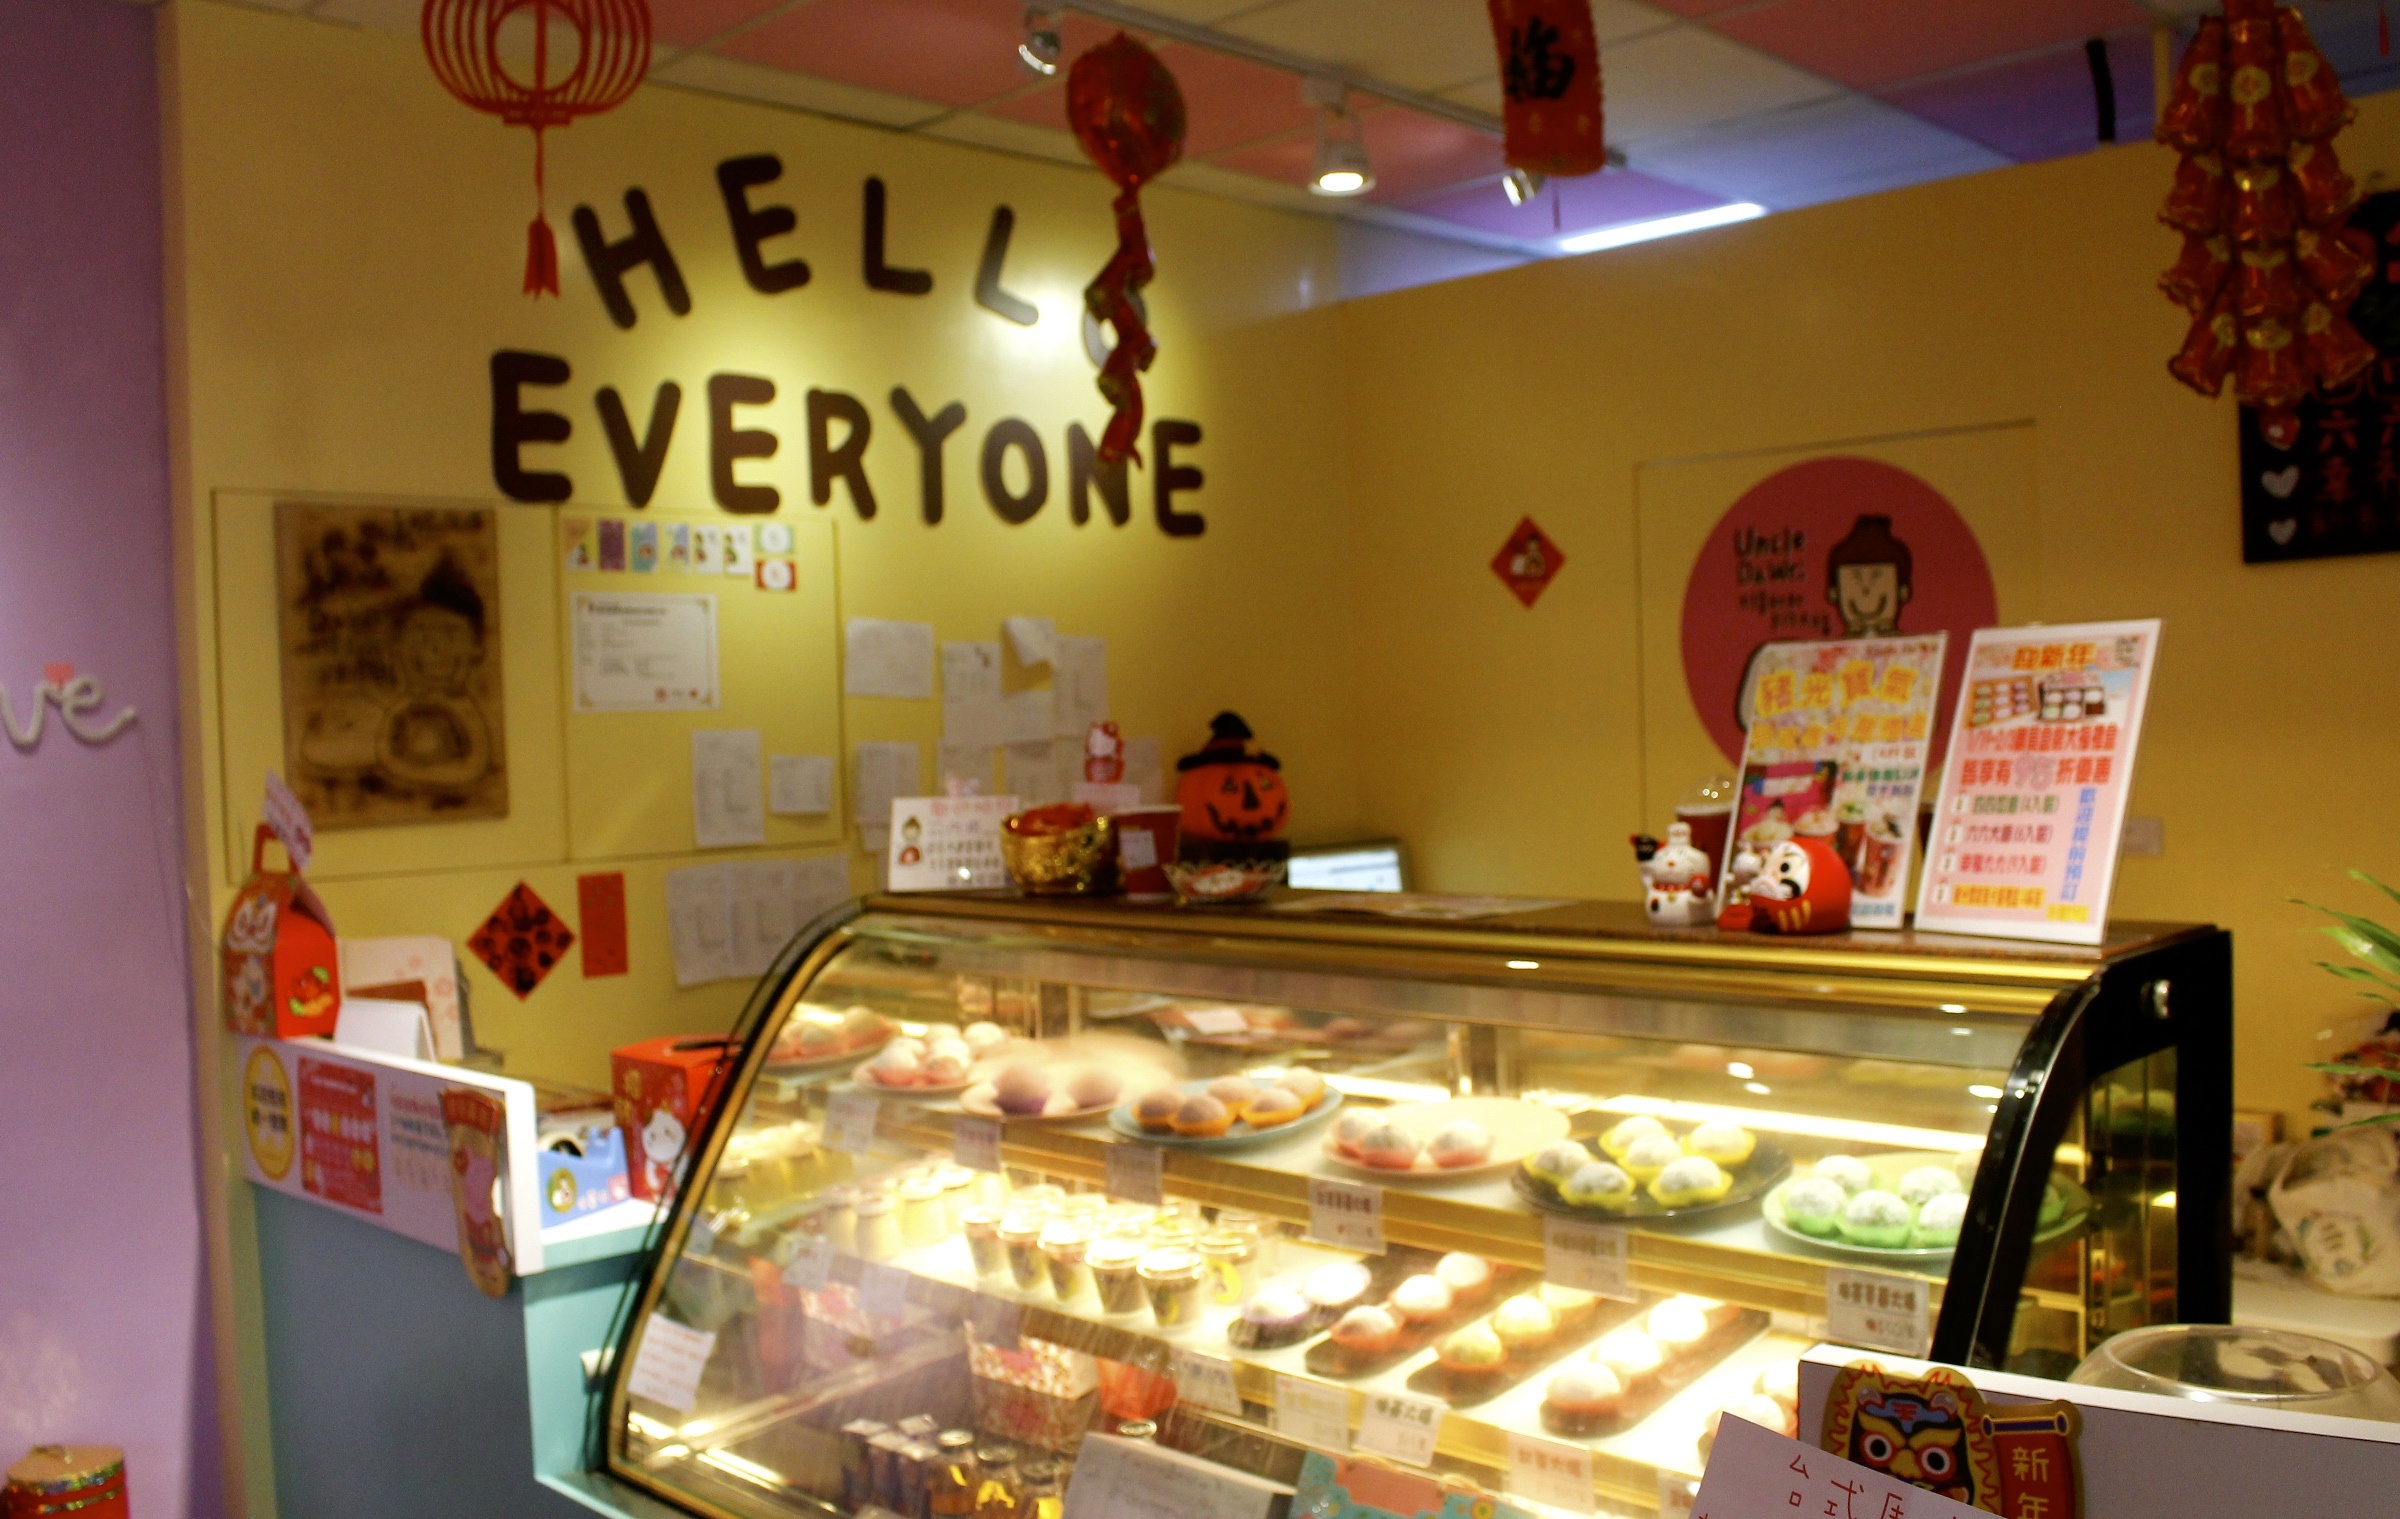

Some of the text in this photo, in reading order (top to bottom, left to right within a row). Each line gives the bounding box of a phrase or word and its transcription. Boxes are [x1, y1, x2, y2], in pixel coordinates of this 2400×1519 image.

[491, 349, 1206, 536] EVERYONE
[1734, 527, 1804, 556] Uncle
[2012, 1446, 2050, 1519] 新年
